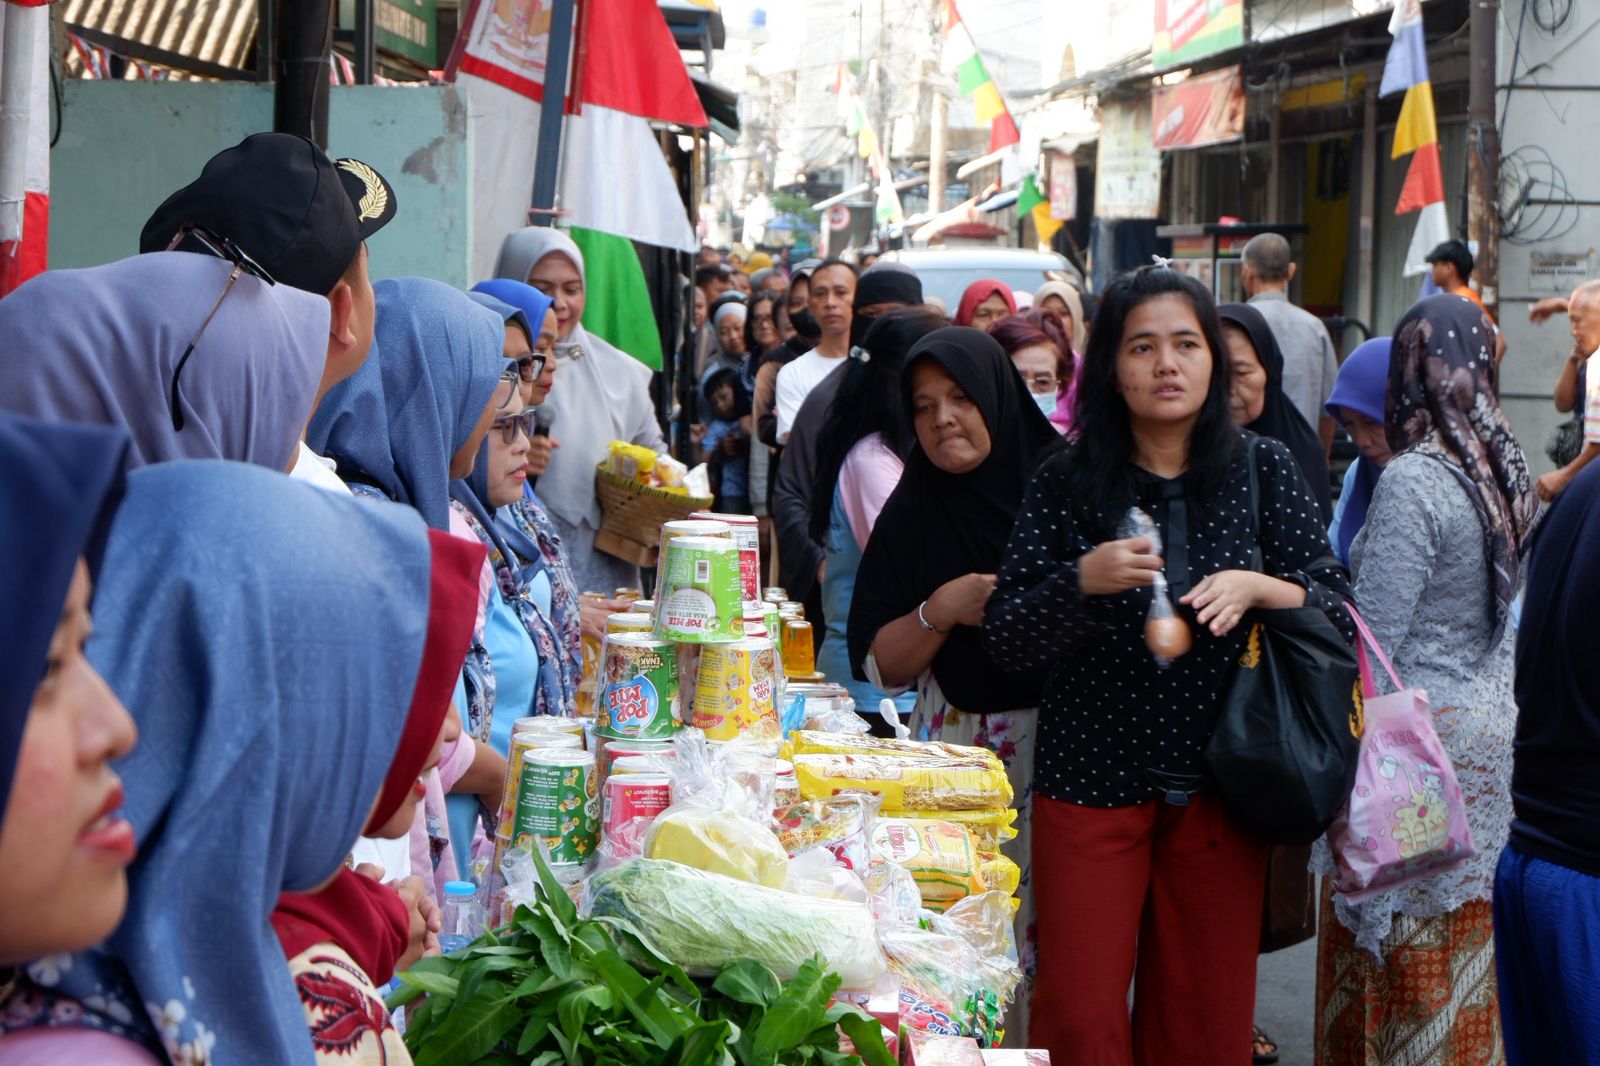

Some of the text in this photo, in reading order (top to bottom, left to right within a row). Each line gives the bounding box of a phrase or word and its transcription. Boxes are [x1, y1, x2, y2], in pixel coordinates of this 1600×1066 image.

[668, 616, 702, 628] POP MIE
[640, 656, 661, 666] ENAK
[608, 684, 642, 709] MIE
[616, 698, 649, 723] POP
